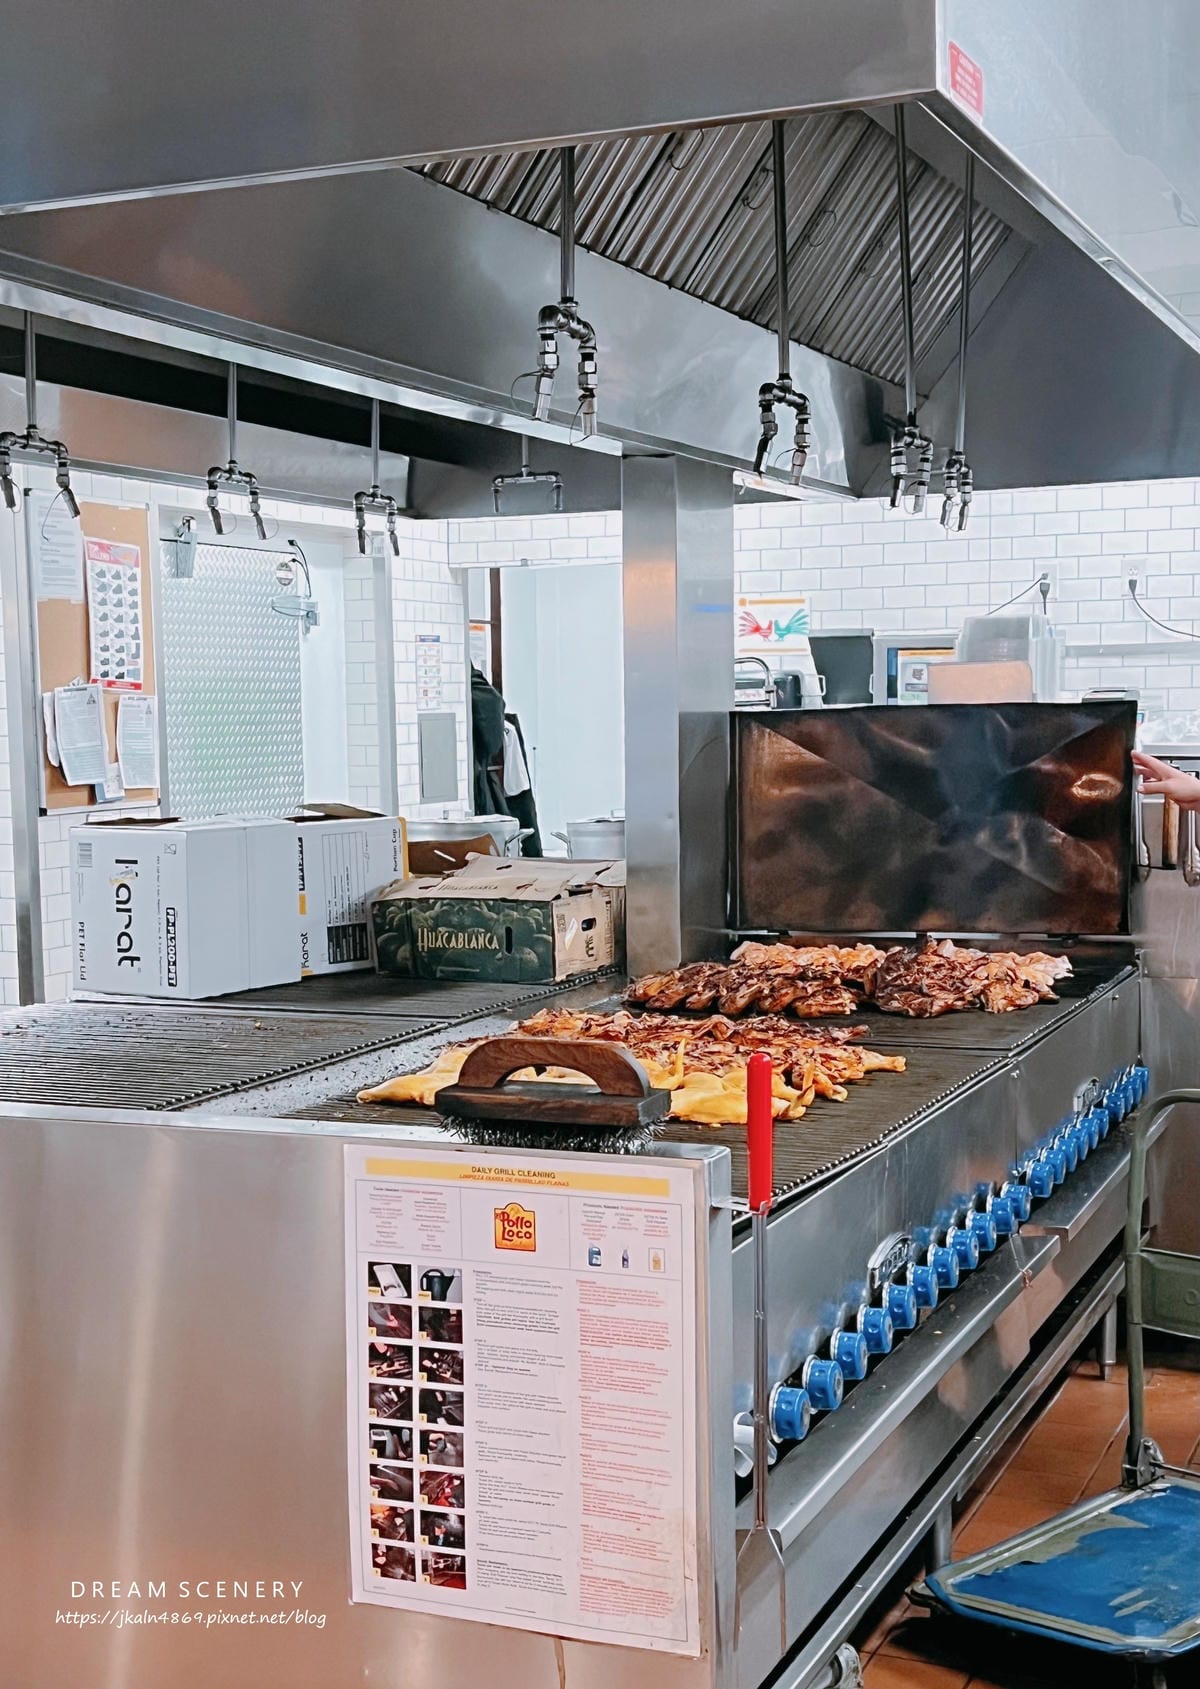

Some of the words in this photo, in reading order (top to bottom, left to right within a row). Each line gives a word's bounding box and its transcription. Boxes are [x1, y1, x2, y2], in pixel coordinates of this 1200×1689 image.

[418, 927, 500, 952] HUACABLANCA
[79, 966, 87, 981] Lid
[471, 1166, 493, 1175] DAILY
[494, 1167, 516, 1177] GRILL
[517, 1170, 556, 1179] CLEANING
[500, 1211, 533, 1230] Pollo
[502, 1227, 533, 1242] Loco
